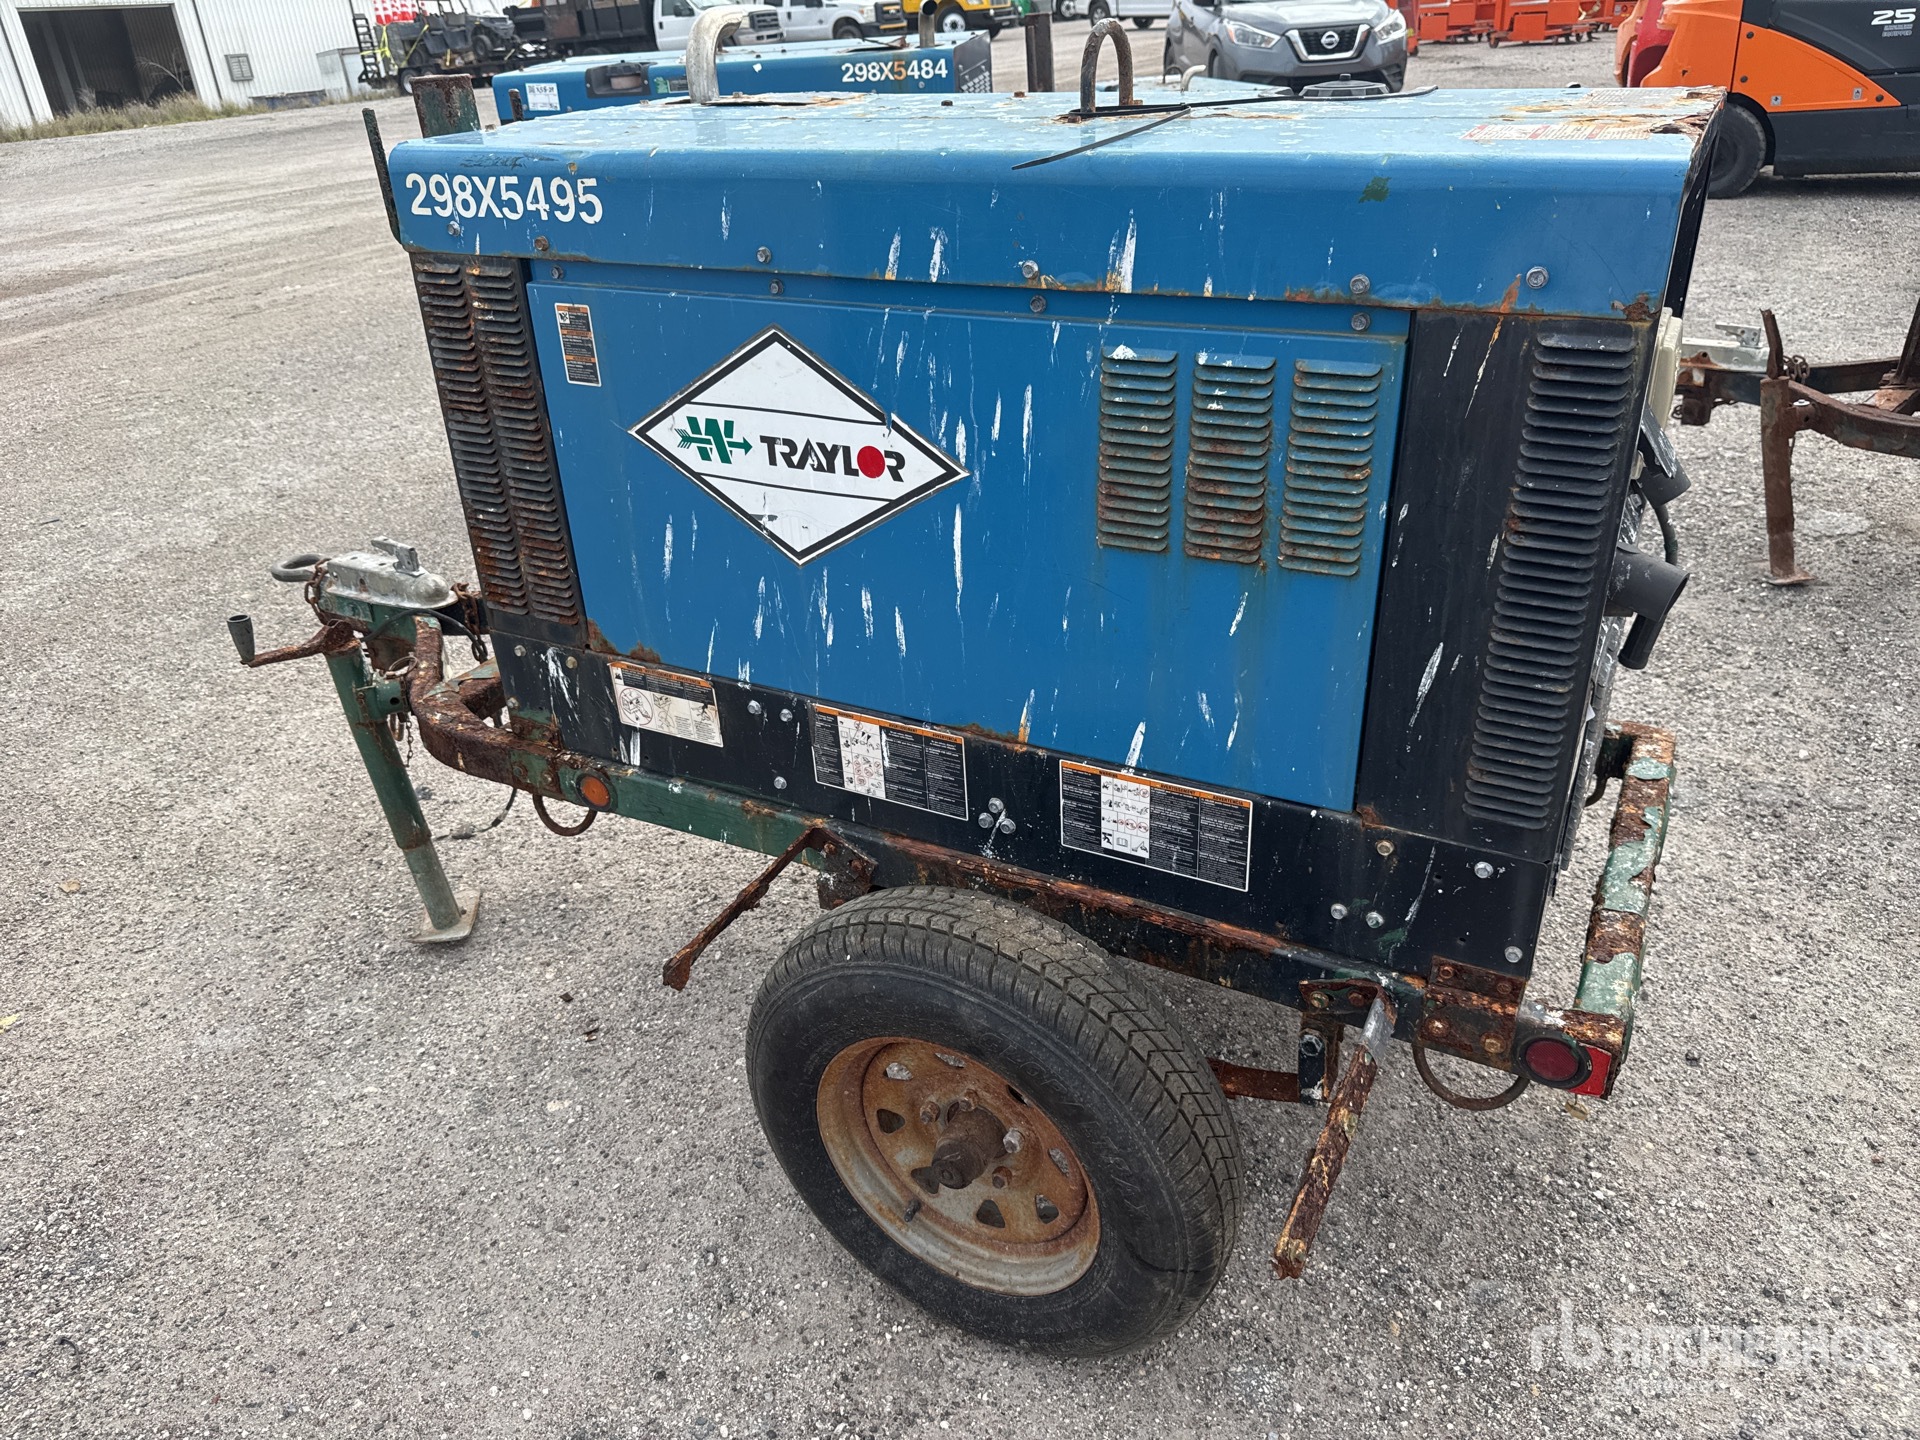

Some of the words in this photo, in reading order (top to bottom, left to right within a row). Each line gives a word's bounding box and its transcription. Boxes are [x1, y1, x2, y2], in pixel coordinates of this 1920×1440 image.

[1871, 8, 1916, 25] 25
[841, 58, 948, 83] 298X5484
[405, 172, 604, 225] 298X5495
[760, 434, 906, 482] TRAYLOR
